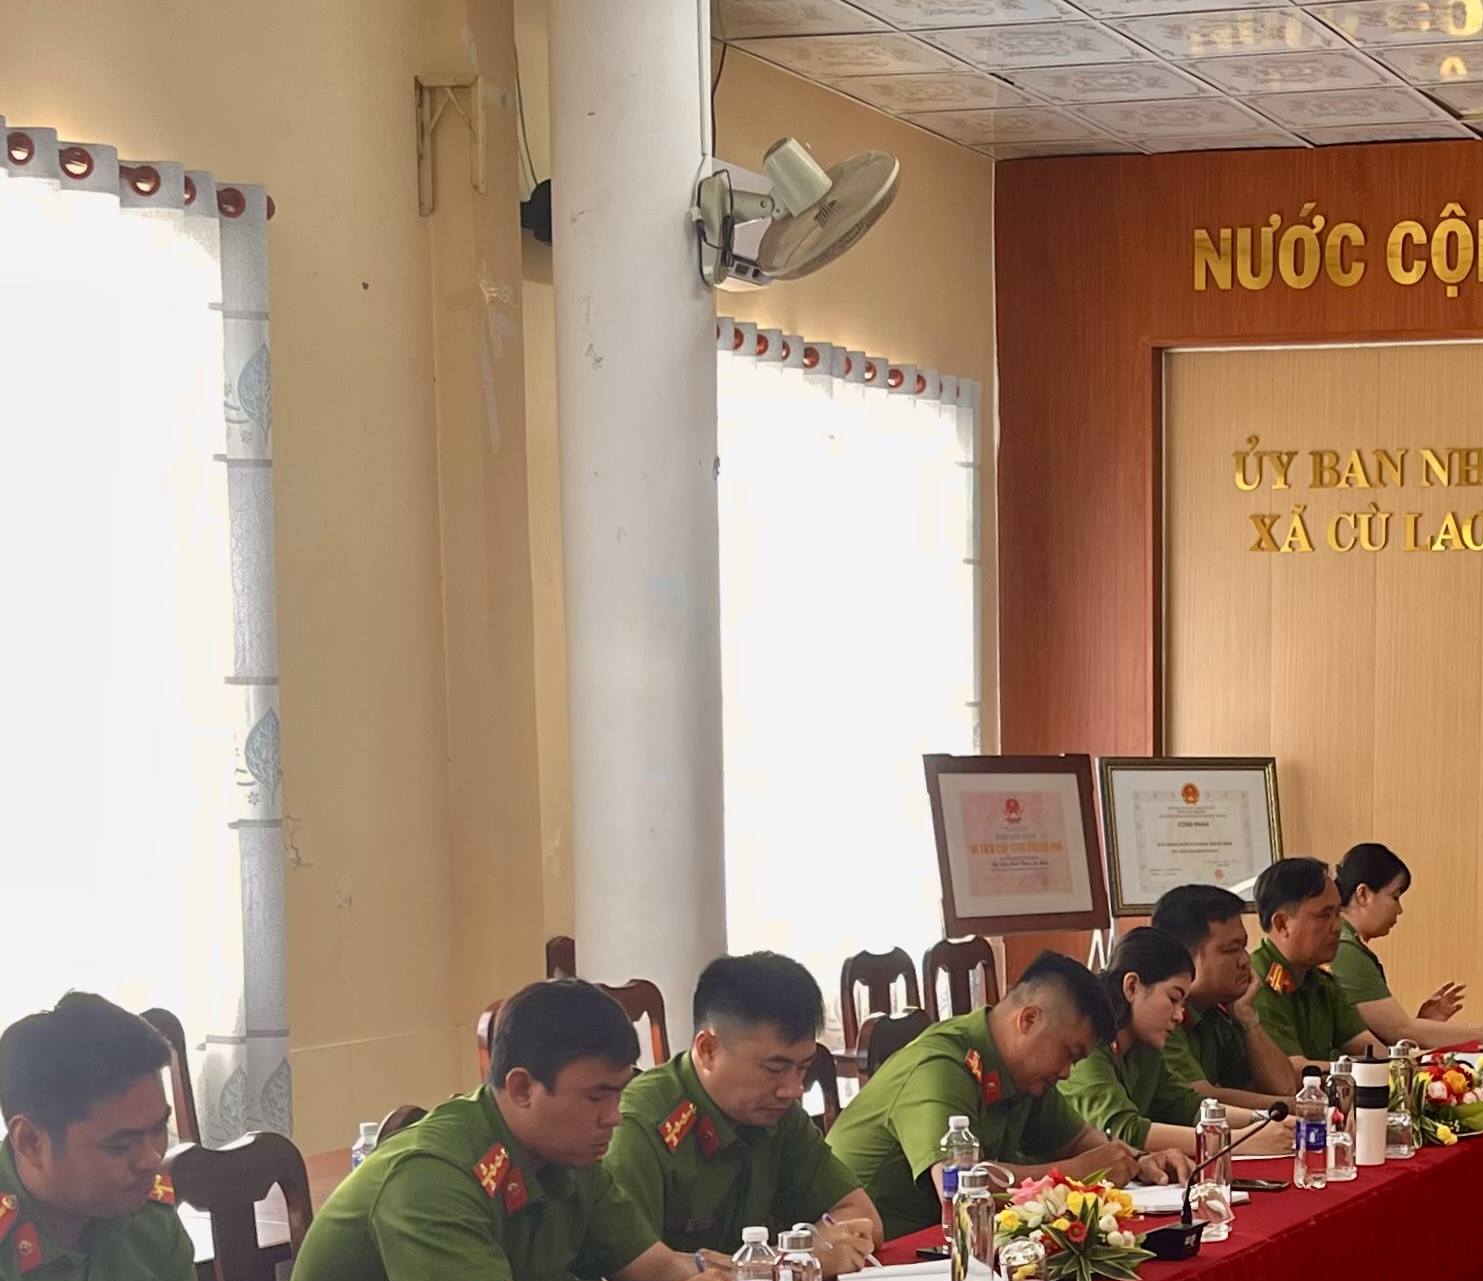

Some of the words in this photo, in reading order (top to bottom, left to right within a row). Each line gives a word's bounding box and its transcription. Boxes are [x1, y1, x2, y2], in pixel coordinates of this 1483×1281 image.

[1193, 201, 1366, 291] NƯỚC
[1231, 434, 1299, 491] ỦY
[1308, 448, 1409, 489] BAN
[1249, 504, 1316, 553] XÃ
[1327, 501, 1393, 552] CÙ
